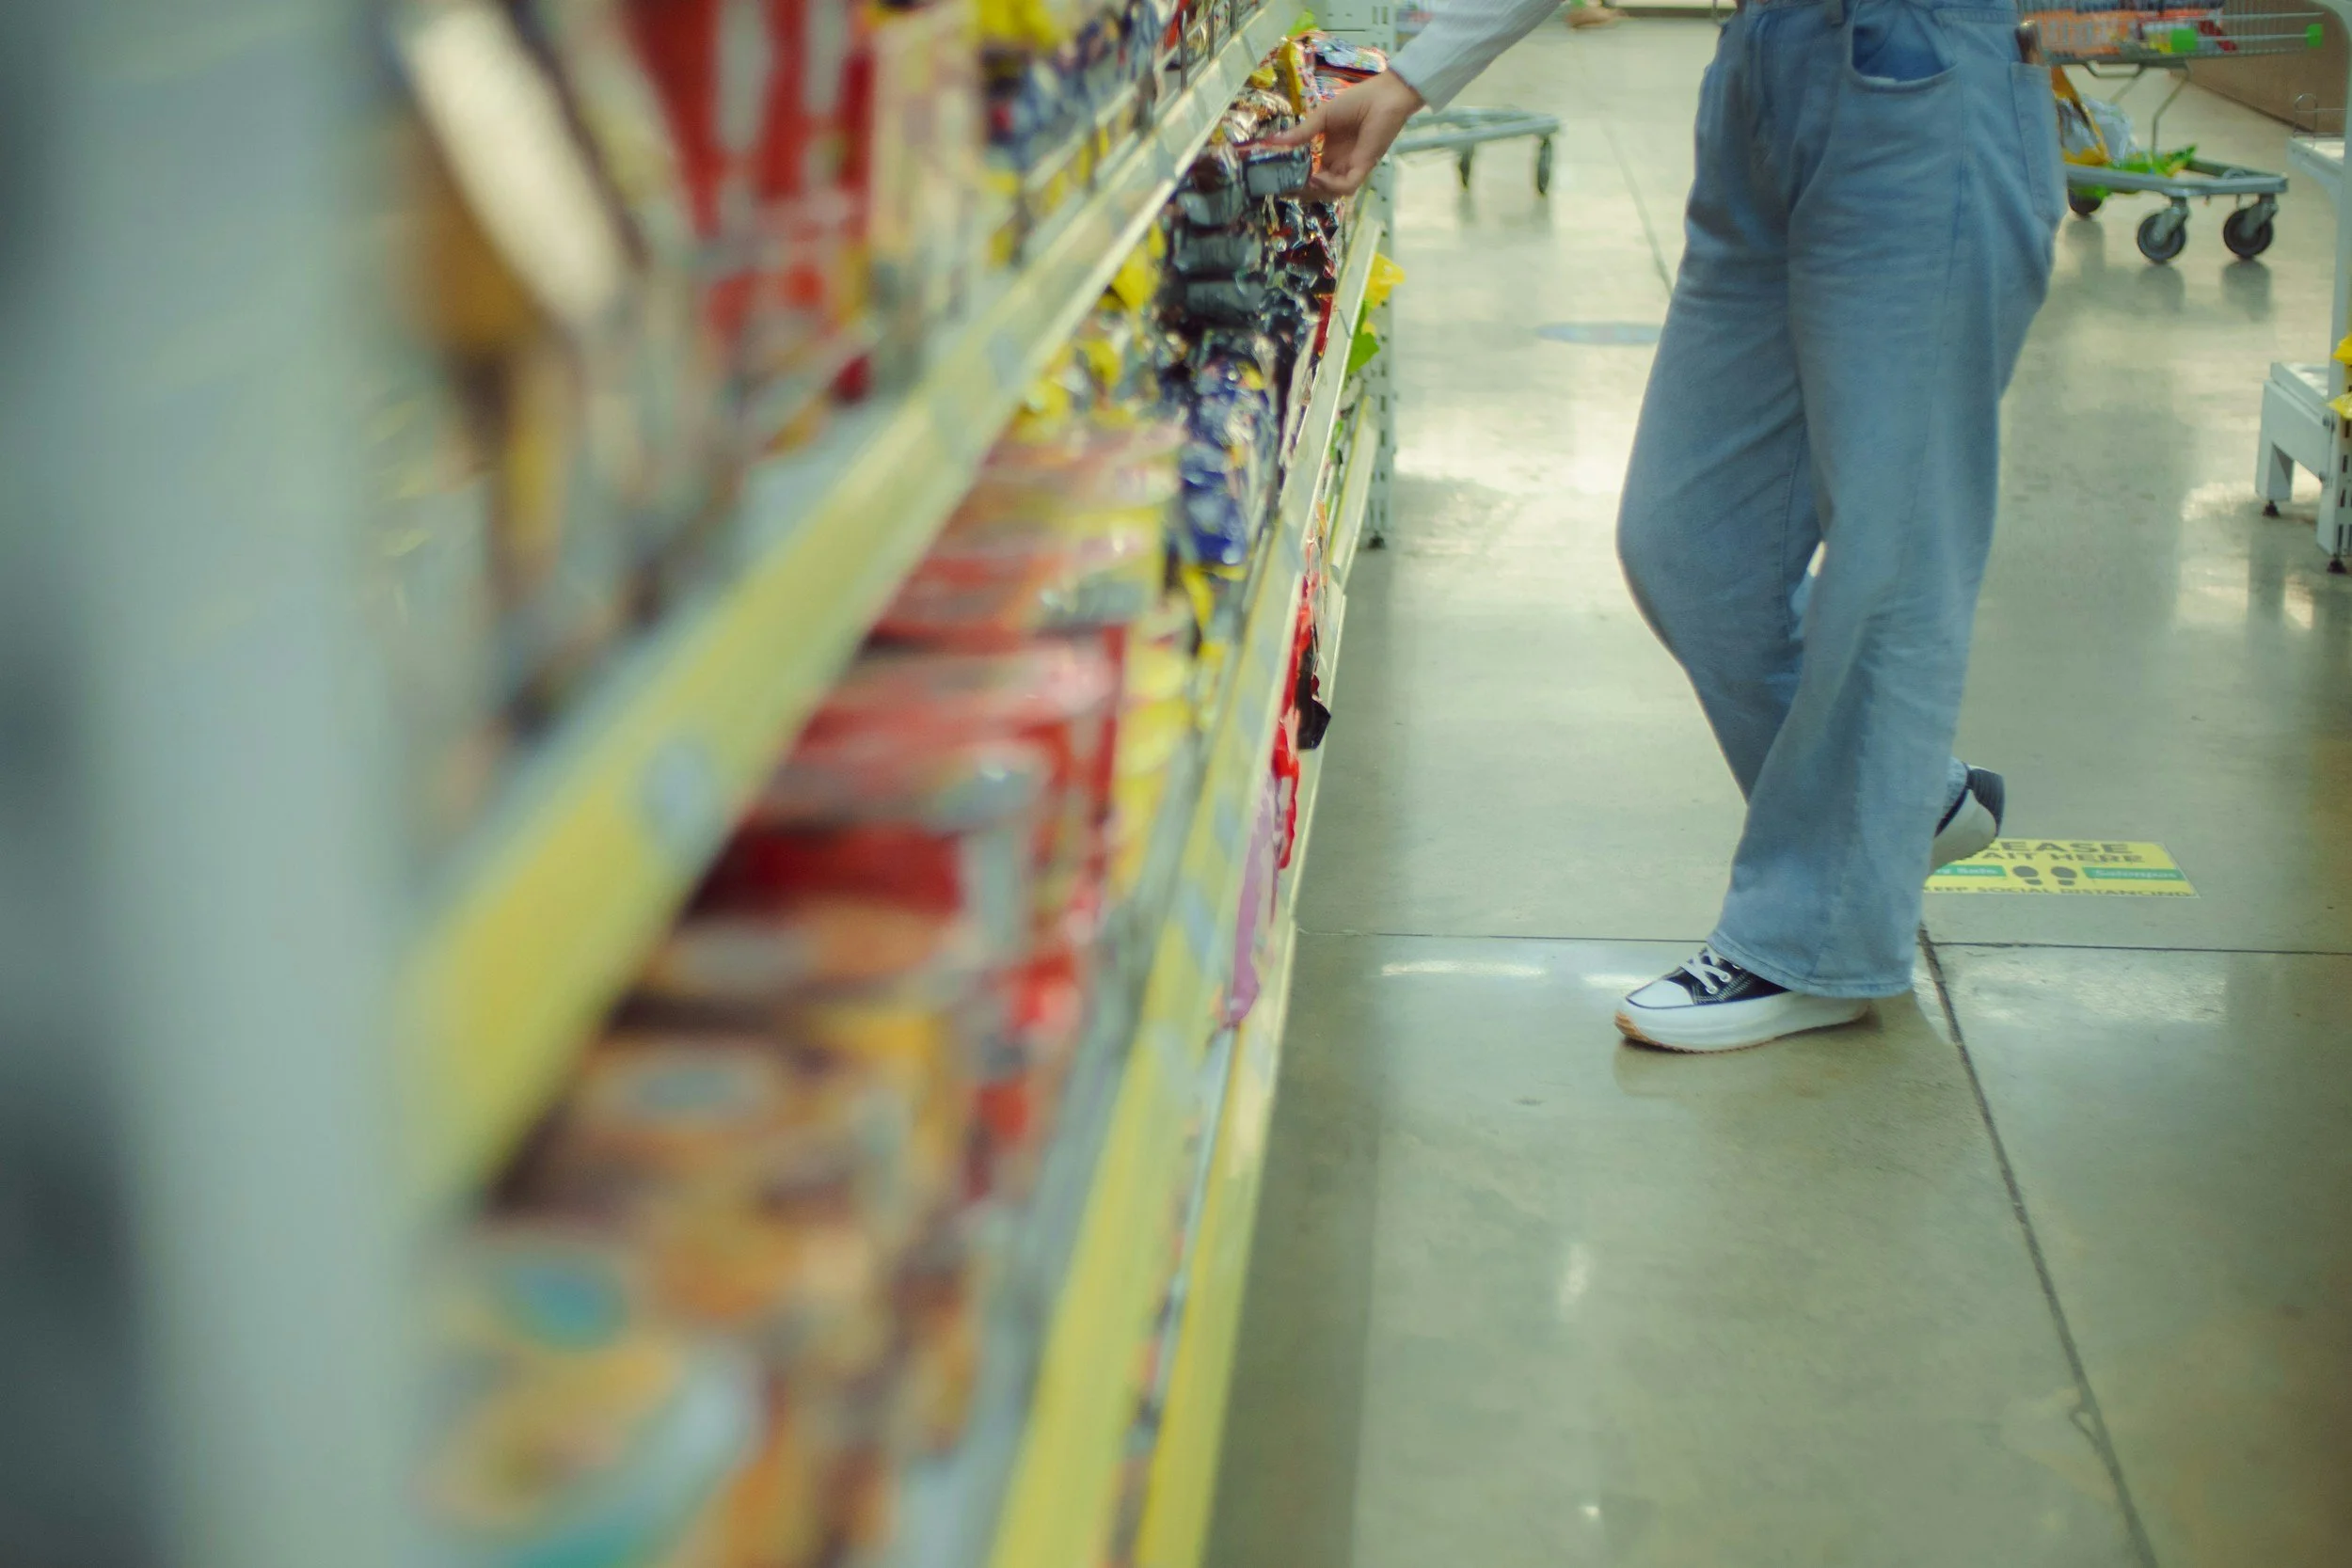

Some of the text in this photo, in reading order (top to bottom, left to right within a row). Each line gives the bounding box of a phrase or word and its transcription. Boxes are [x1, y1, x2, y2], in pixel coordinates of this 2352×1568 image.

[1988, 841, 2133, 854] EASE
[1981, 851, 2146, 863] AIT HERE
